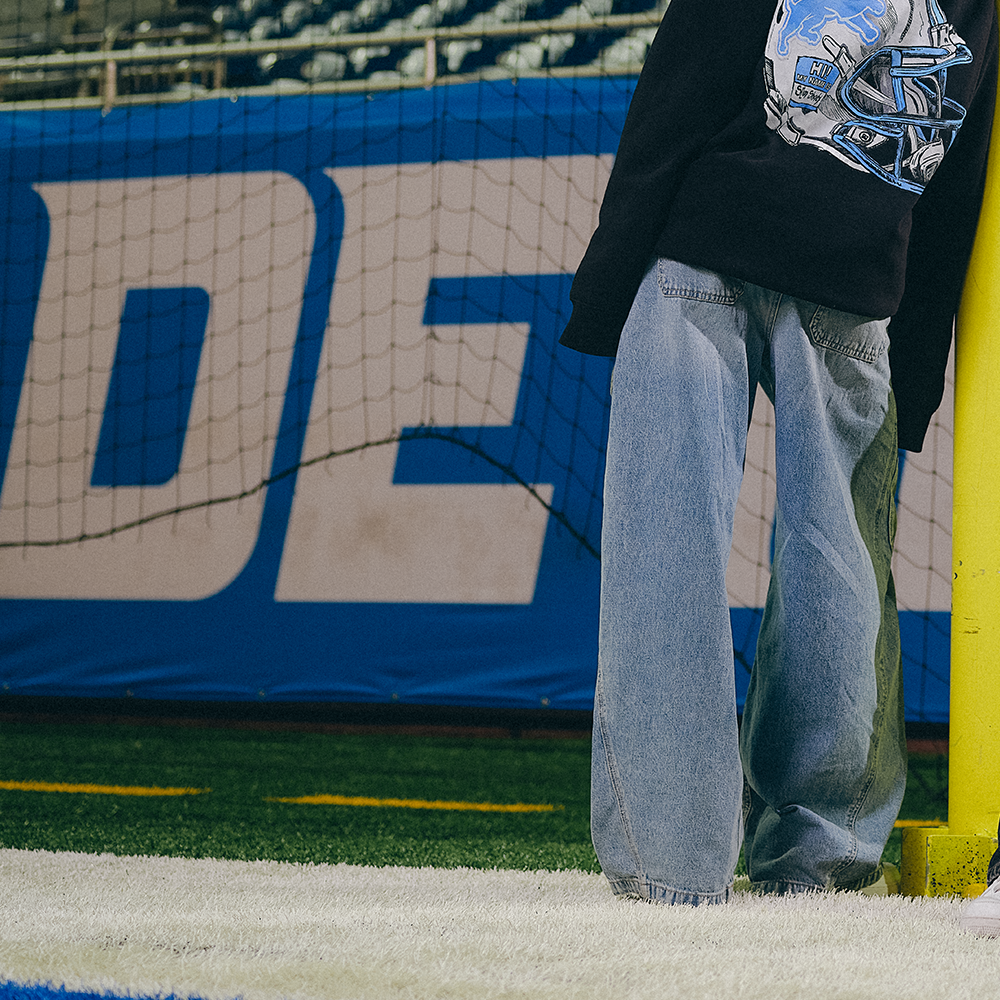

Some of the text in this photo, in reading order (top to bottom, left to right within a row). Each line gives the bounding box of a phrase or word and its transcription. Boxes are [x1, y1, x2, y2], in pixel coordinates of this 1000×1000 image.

[810, 61, 833, 80] HI!
[796, 74, 808, 83] MY
[808, 76, 826, 89] NAME
